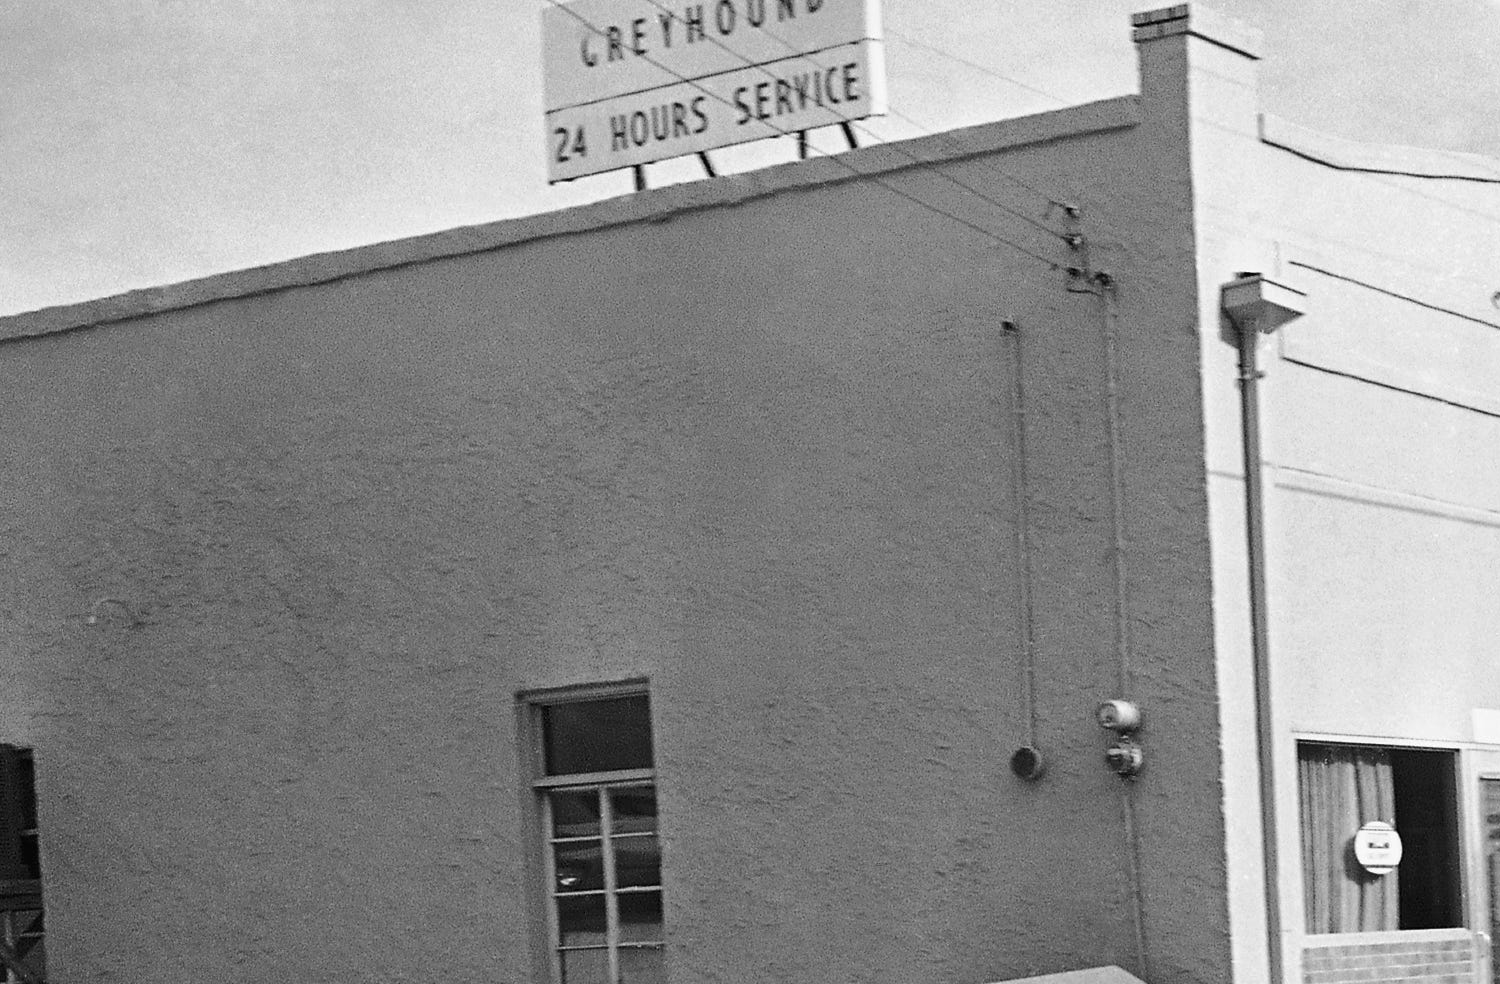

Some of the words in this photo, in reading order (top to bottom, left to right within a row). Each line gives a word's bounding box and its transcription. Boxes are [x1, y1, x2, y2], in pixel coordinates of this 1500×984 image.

[554, 126, 588, 163] 24
[610, 97, 709, 151] HOURS
[734, 62, 859, 126] SERVICE
